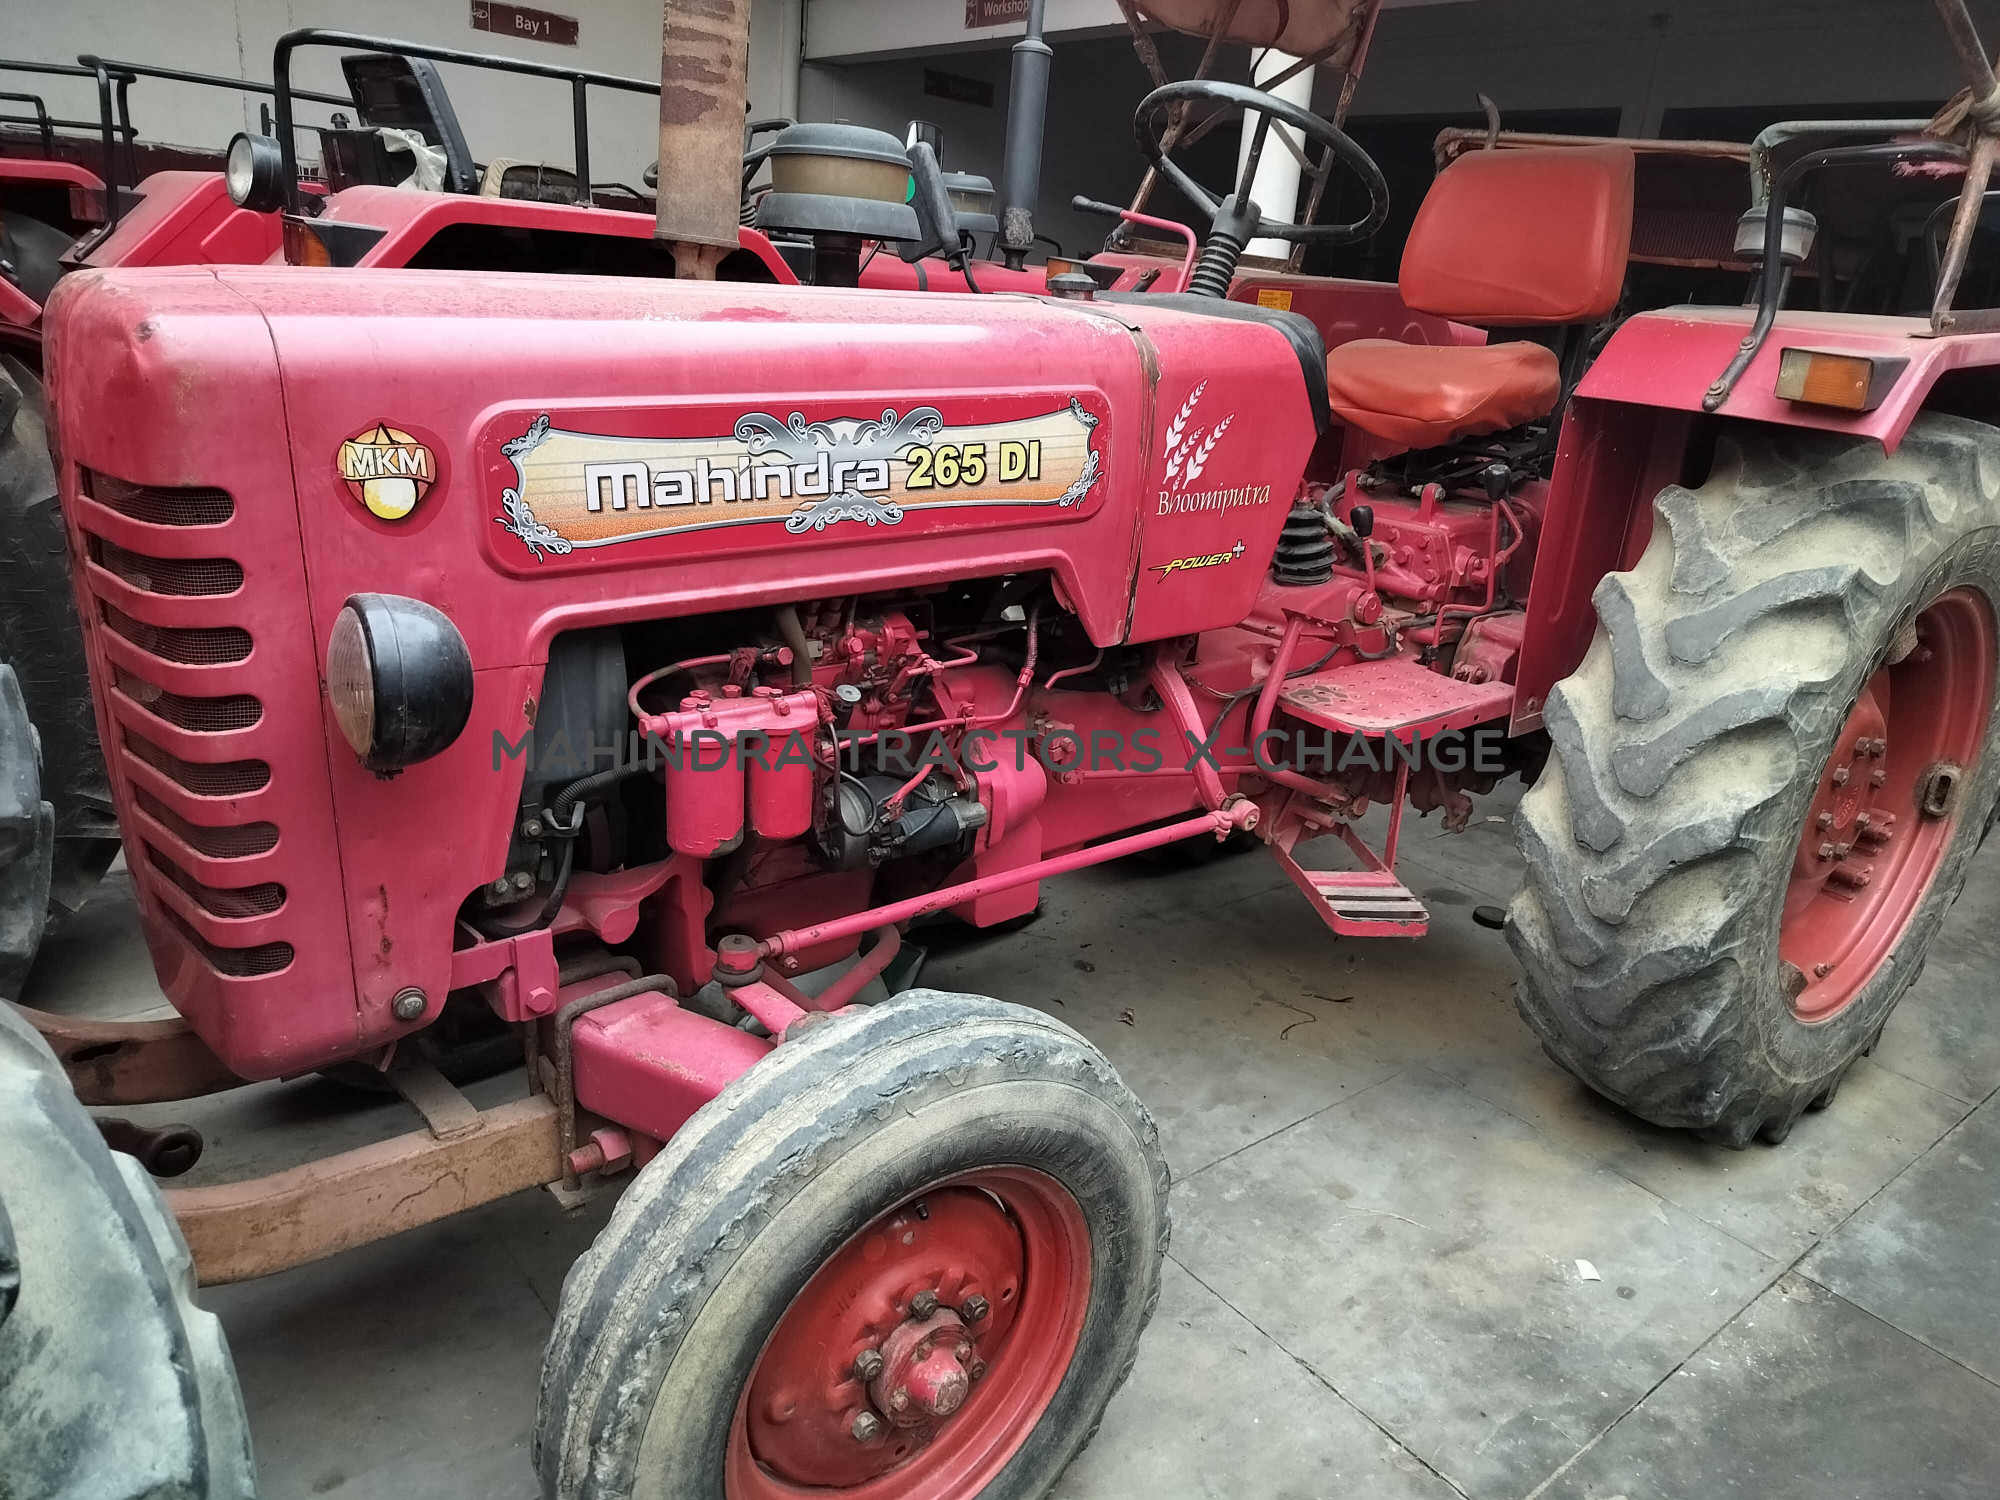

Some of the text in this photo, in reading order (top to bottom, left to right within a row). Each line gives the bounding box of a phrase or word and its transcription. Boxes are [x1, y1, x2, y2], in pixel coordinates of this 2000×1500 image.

[515, 14, 550, 36] Bay 1
[984, 0, 1029, 17] Workshop
[344, 443, 429, 478] MKM
[585, 439, 1041, 512] Mahindra 265 DI
[1155, 481, 1271, 519] Bhoomiputra
